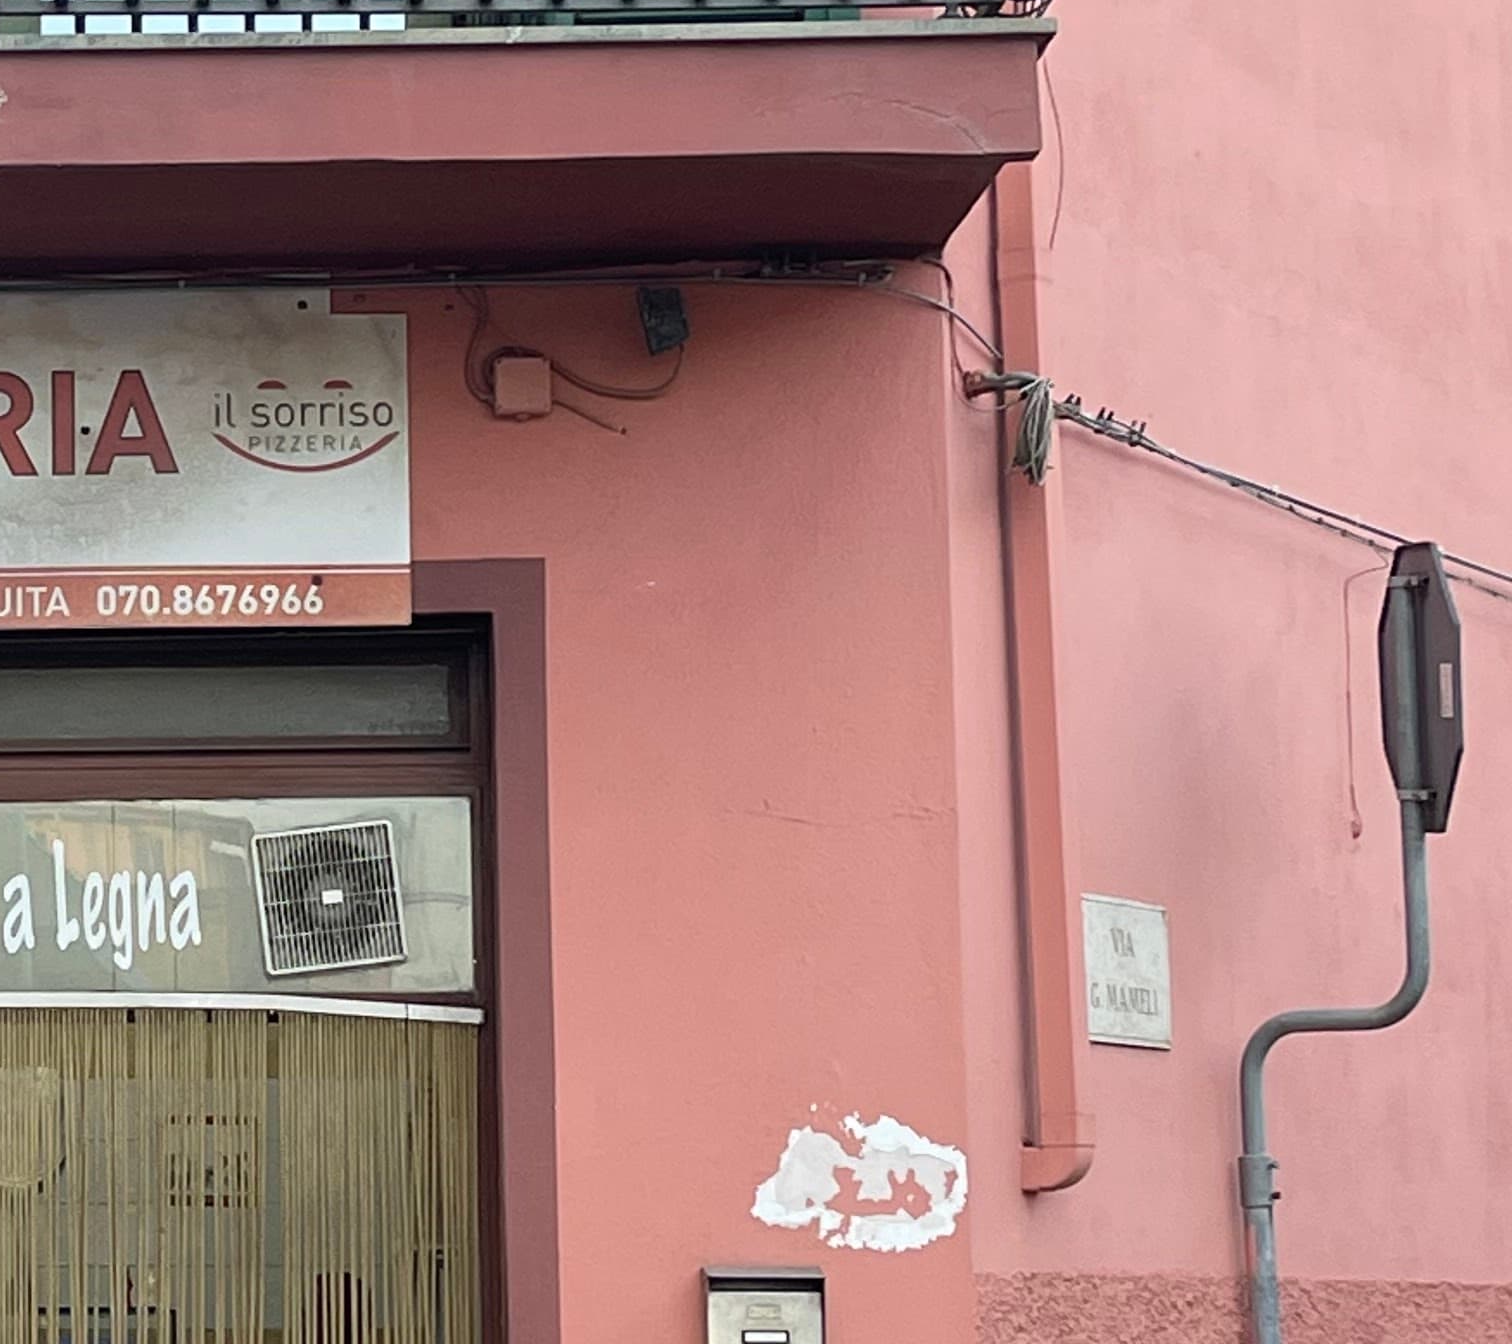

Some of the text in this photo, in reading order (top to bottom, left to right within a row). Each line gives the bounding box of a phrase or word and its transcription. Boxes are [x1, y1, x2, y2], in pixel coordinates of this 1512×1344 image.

[212, 393, 394, 429] il sorriso
[248, 435, 363, 453] PIZZERIA
[96, 584, 323, 616] 070.8676966
[2, 872, 36, 955] a
[54, 838, 202, 970] Legna
[1109, 927, 1136, 958] VIA
